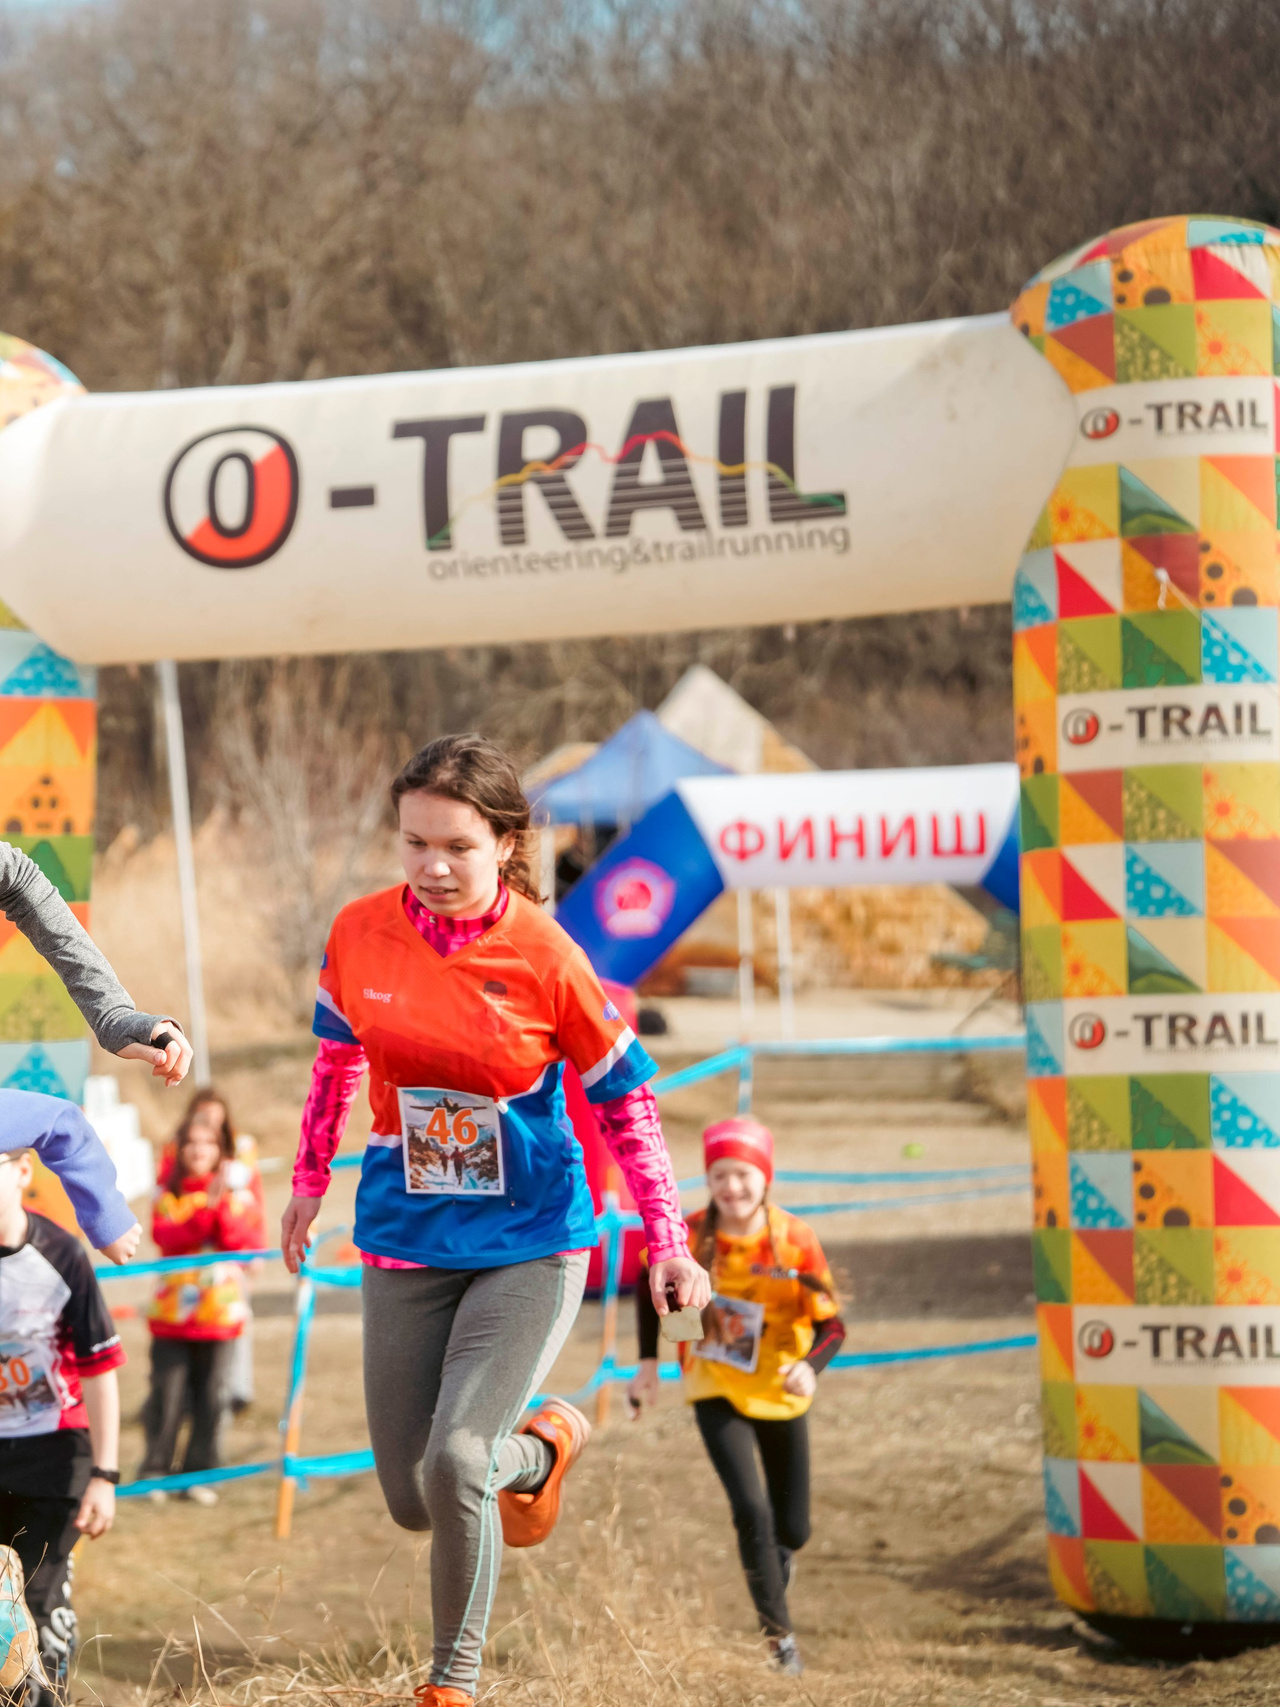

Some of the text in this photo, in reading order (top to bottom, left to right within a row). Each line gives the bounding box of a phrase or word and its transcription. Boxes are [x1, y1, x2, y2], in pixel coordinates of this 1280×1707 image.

[427, 521, 851, 582] orienteering&trailrunning
[718, 811, 987, 862] ФИНИШ
[363, 988, 392, 1003] Skog
[425, 1106, 480, 1146] 46
